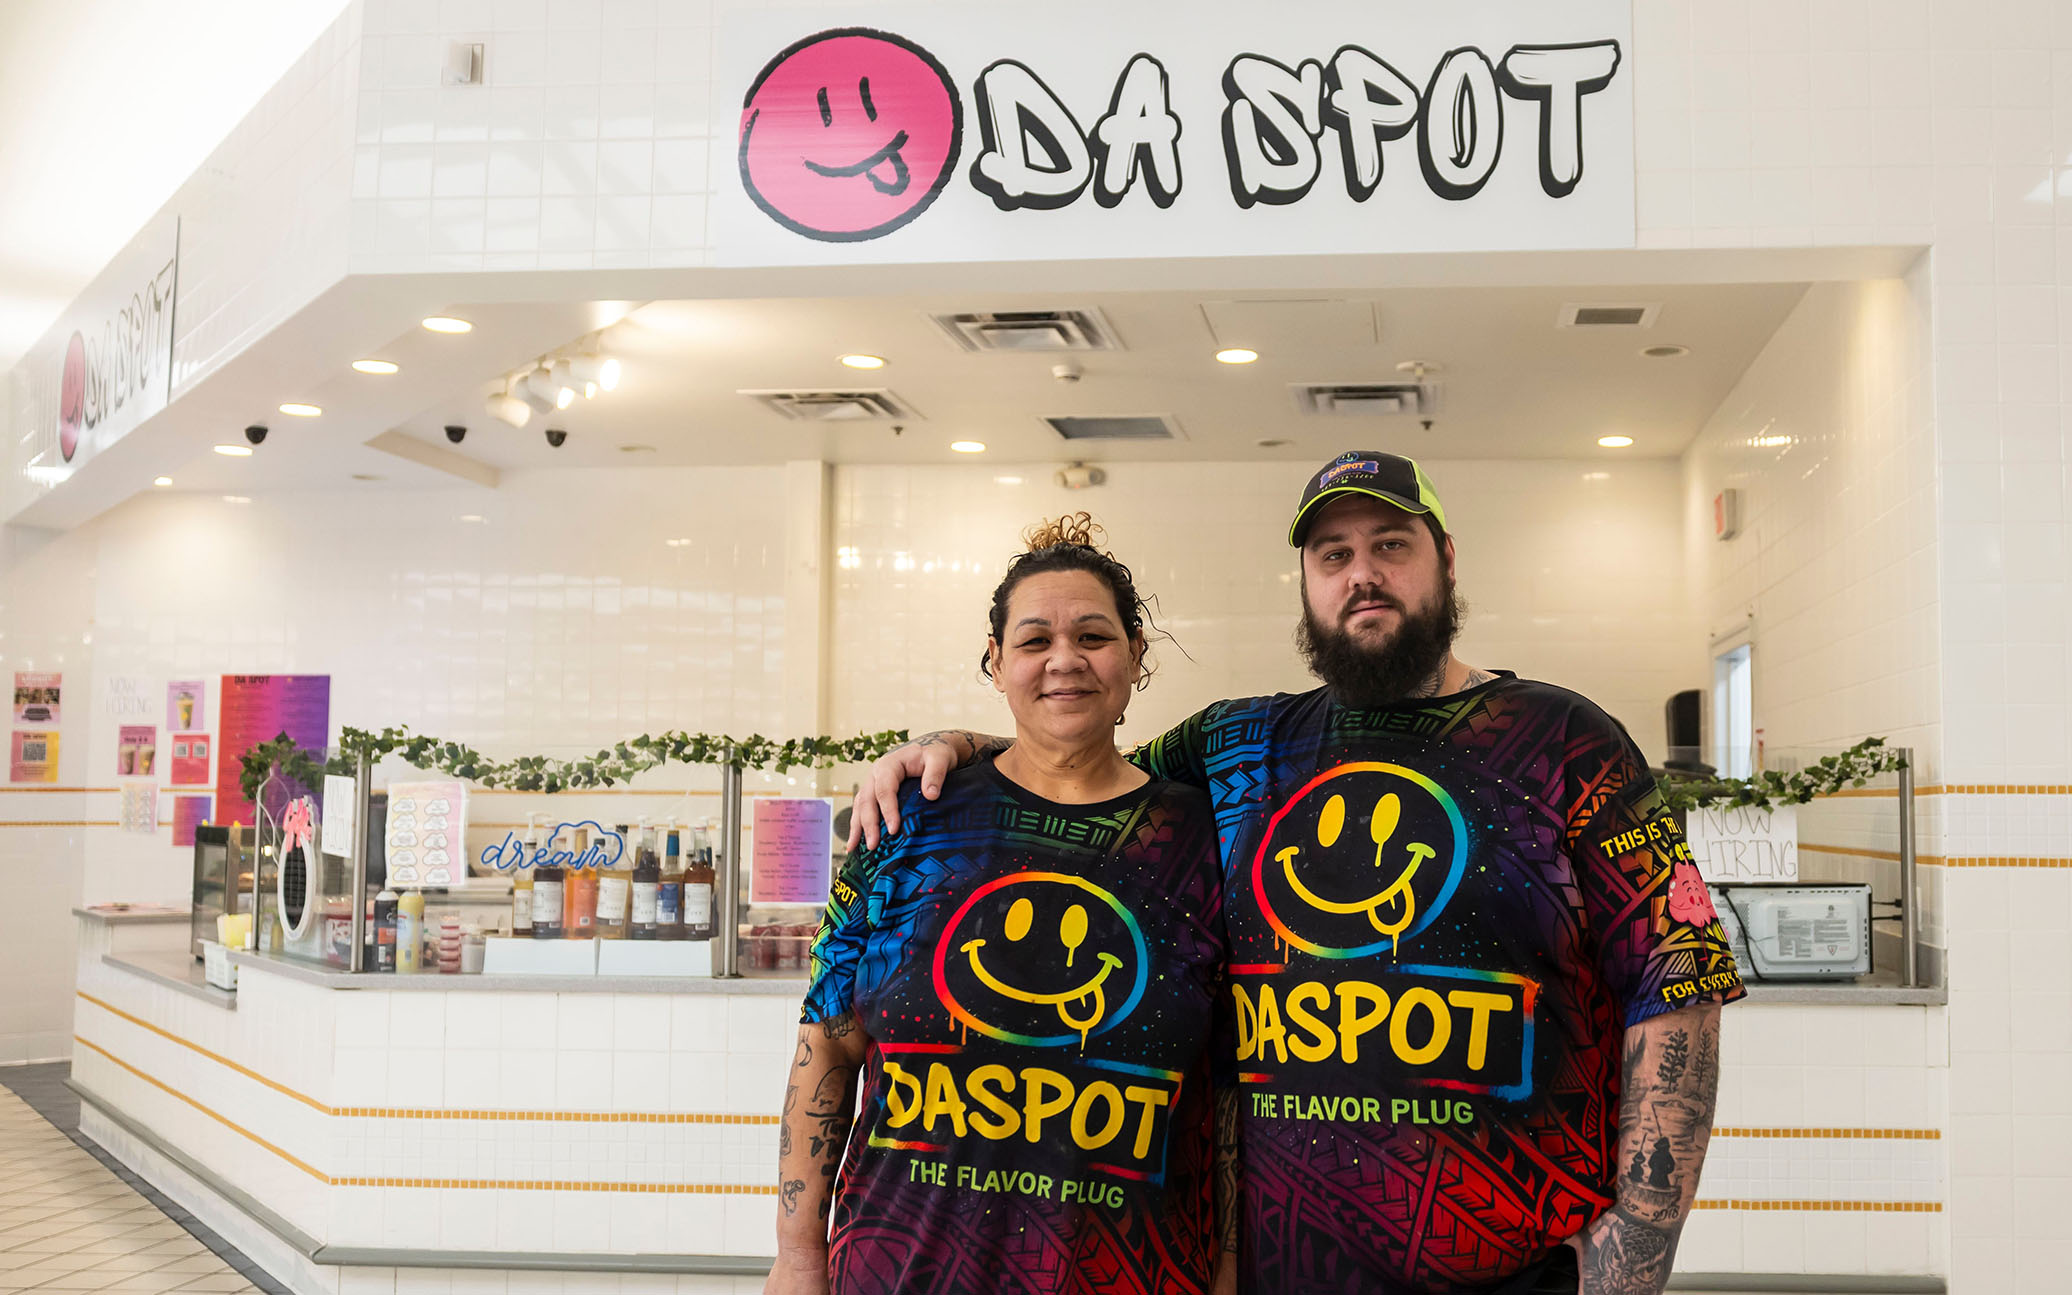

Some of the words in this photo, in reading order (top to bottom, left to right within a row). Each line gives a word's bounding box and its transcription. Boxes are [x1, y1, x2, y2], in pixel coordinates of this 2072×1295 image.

[971, 52, 1183, 210] DA
[1221, 38, 1622, 208] SPOT
[114, 258, 174, 408] SPOT
[1600, 827, 1646, 859] THIS
[1645, 822, 1662, 841] IS
[1700, 805, 1771, 838] NOW
[481, 831, 620, 870] dream
[834, 878, 858, 907] SPOT
[1661, 980, 1699, 1003] FOR
[1232, 980, 1513, 1071] DASPOT
[883, 1061, 1169, 1160] DASPOT
[1252, 1092, 1277, 1119] THE
[1284, 1095, 1381, 1122] FLAVOR
[1392, 1099, 1474, 1125] PLUG
[909, 1159, 948, 1186] THE
[957, 1165, 1052, 1200] FLAVOR
[1060, 1179, 1125, 1209] PLUG
